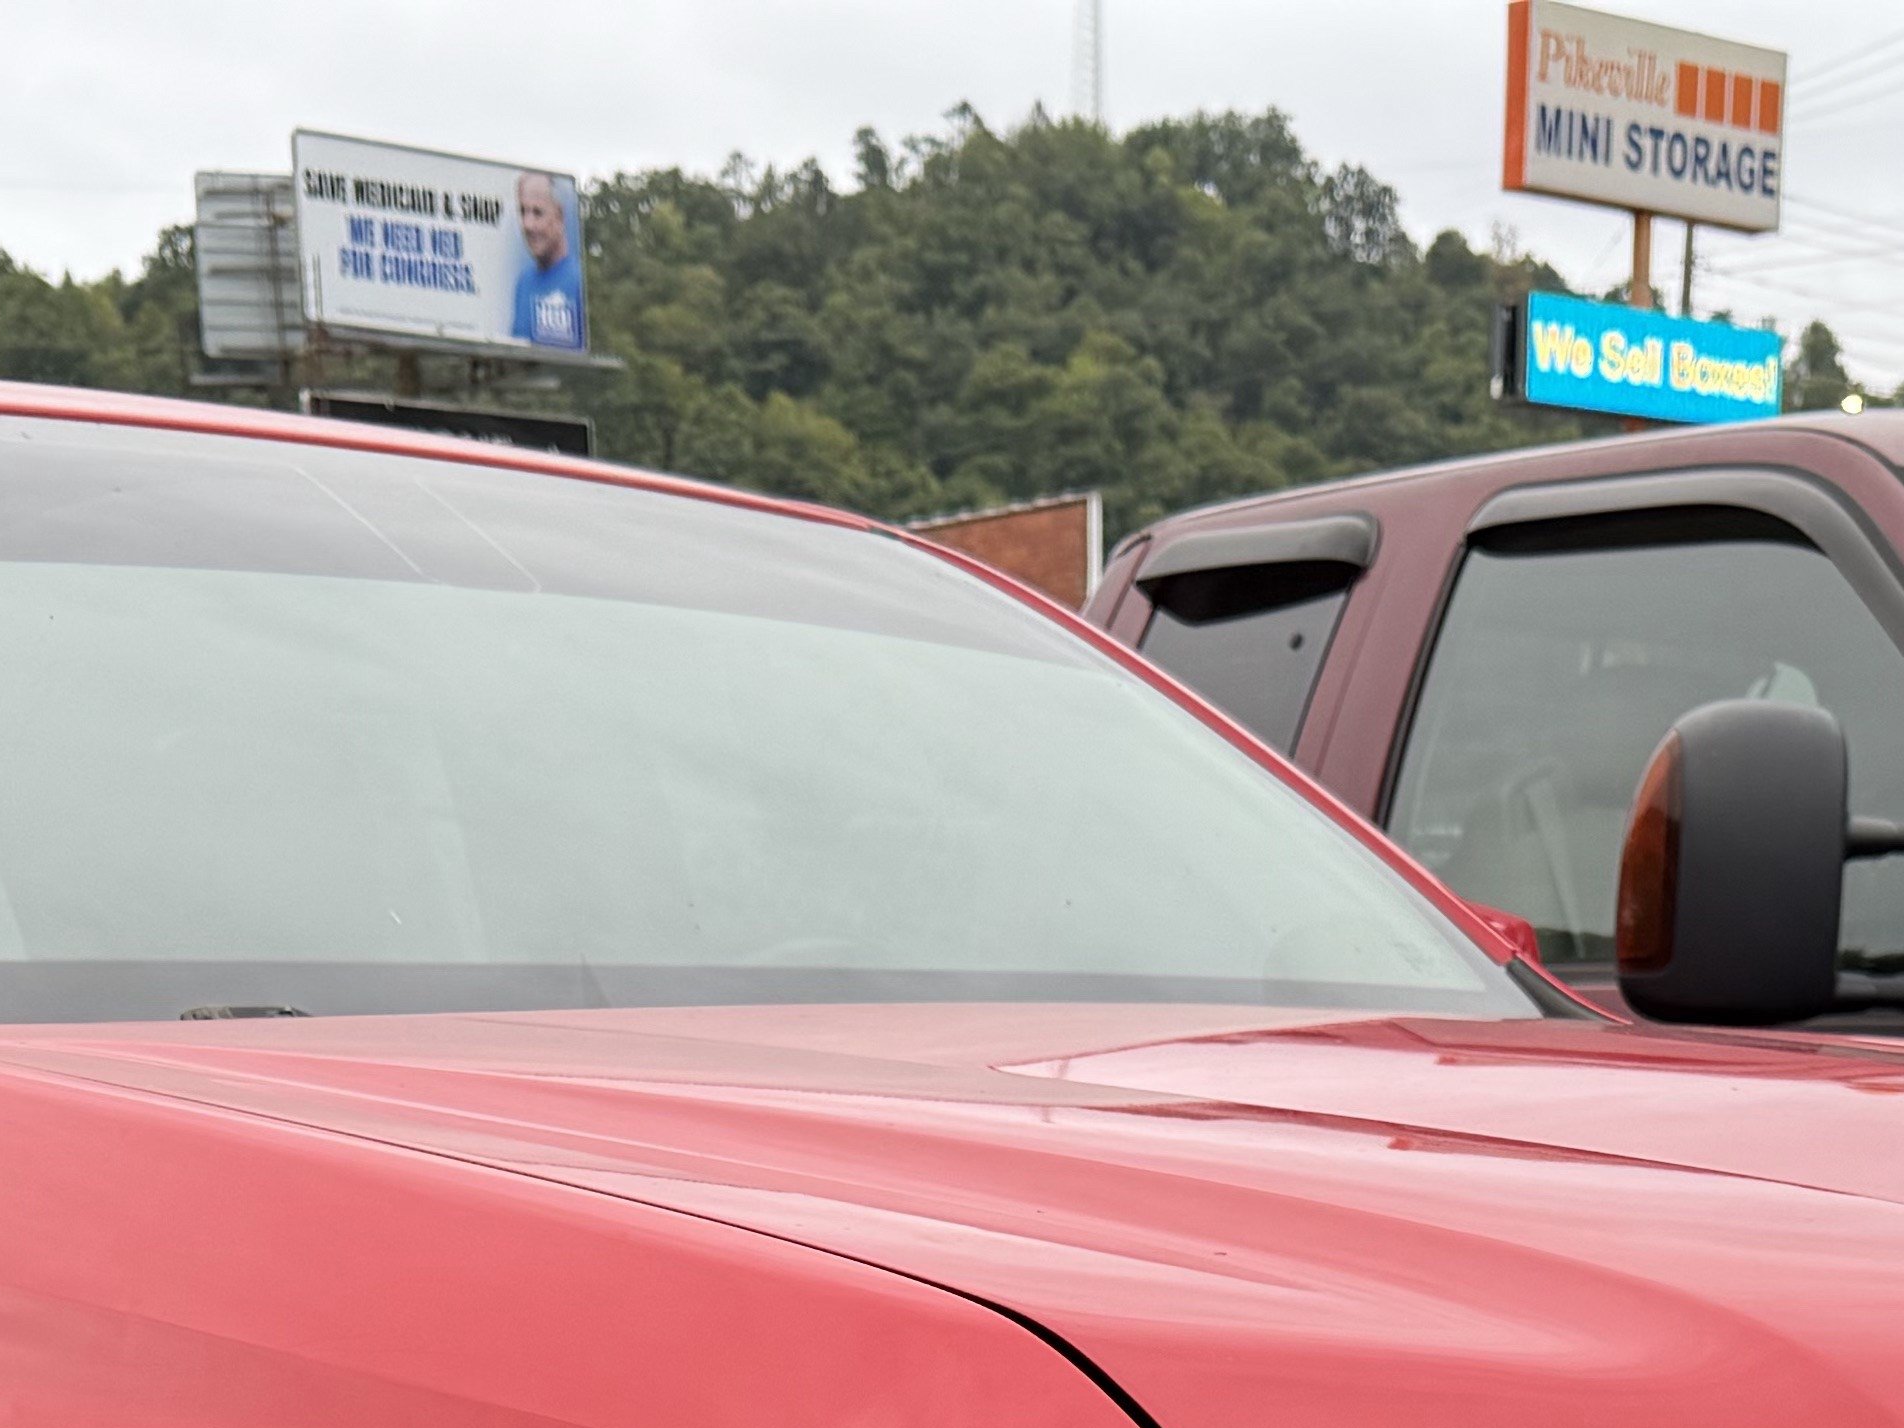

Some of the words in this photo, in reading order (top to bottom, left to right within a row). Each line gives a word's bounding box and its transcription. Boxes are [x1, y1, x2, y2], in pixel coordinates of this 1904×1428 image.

[1538, 28, 1671, 108] Pikeville
[1535, 103, 1613, 168] MINI
[1623, 122, 1778, 198] STORAGE
[304, 168, 347, 200] SAVE
[354, 177, 436, 215] MEDICAID
[339, 248, 373, 279] FOR
[349, 215, 374, 246] WE
[382, 220, 423, 253] NEED
[1532, 320, 1593, 378] We
[1599, 329, 1664, 388] Sell
[1669, 341, 1778, 404] Boxes!
